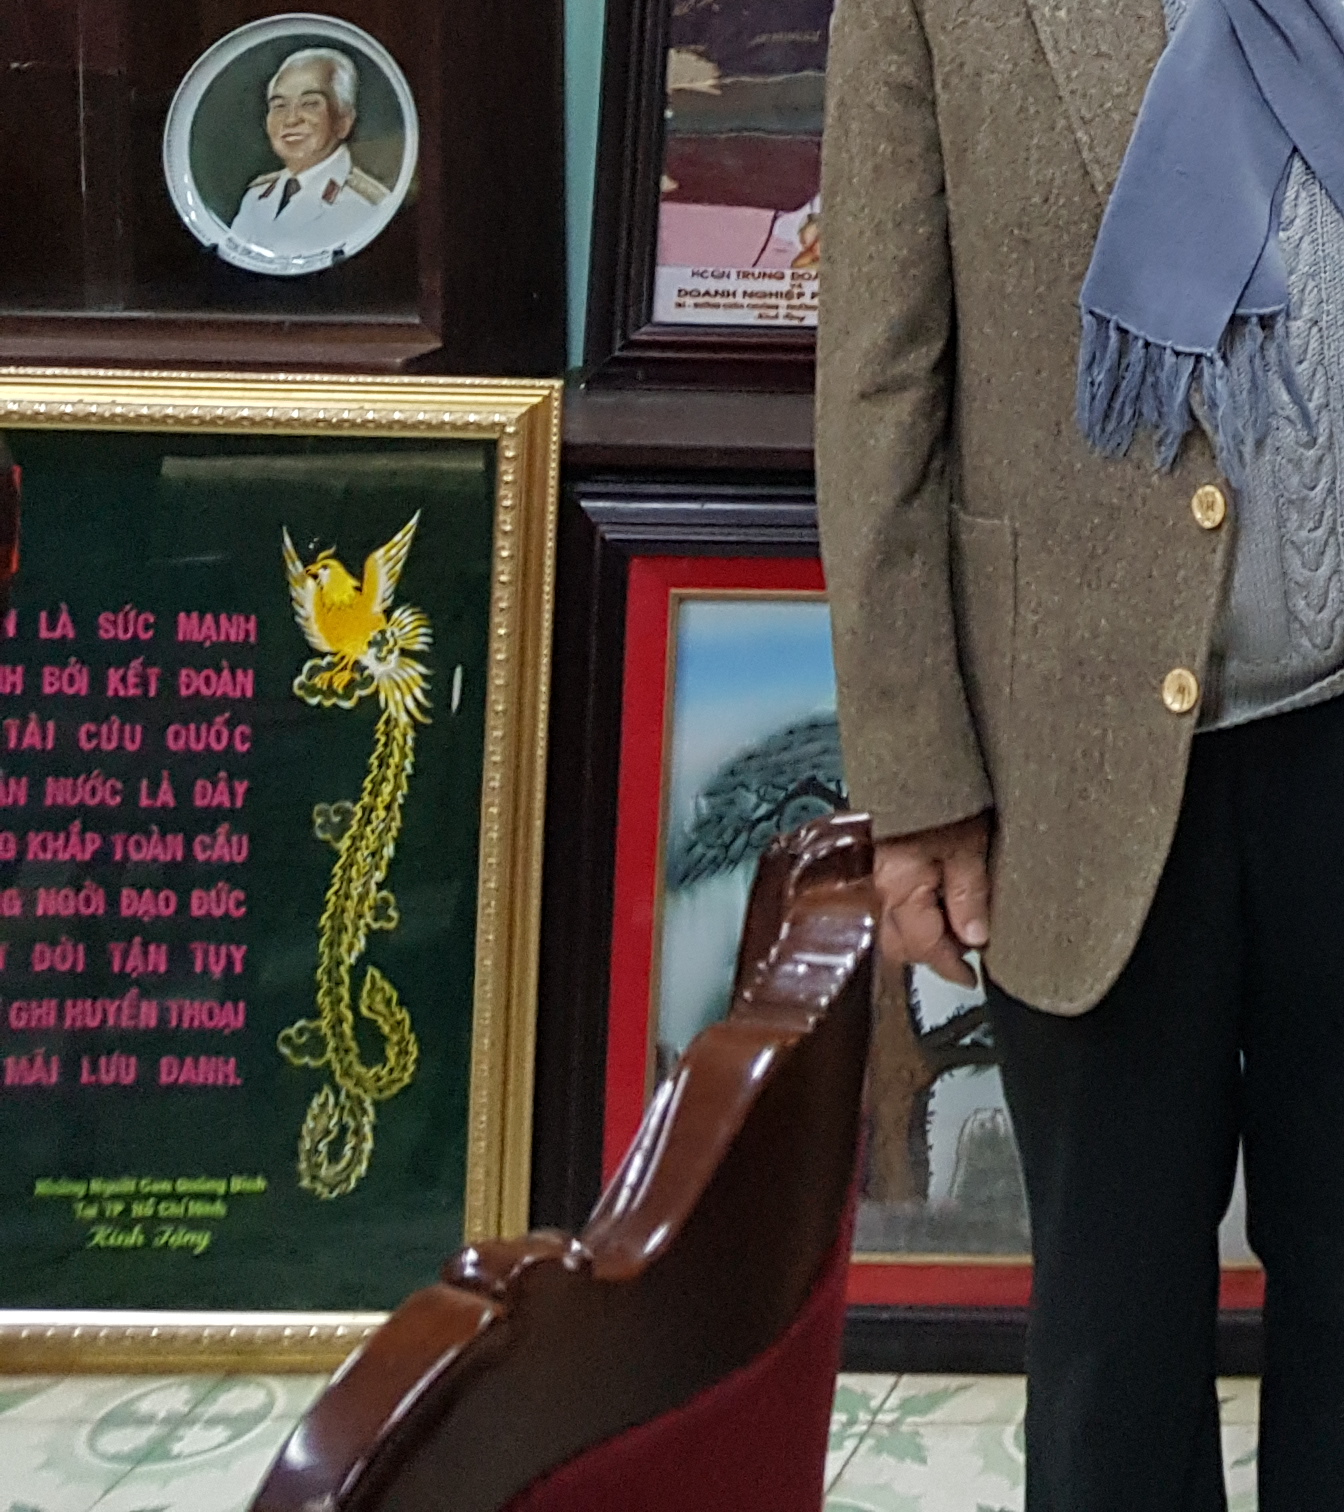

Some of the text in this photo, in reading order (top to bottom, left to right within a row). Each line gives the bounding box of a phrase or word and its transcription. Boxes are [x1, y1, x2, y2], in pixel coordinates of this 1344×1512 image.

[677, 288, 736, 300] DOANH
[97, 606, 156, 641] SỨC
[175, 611, 258, 647] MẠNH
[106, 657, 162, 698] KẾT
[177, 661, 256, 699] ĐOÀN
[138, 770, 177, 809] LÀ
[111, 831, 186, 863] TOÀN
[119, 887, 178, 922] ĐẠO
[189, 941, 248, 978] TỤY
[7, 998, 59, 1032] GHI
